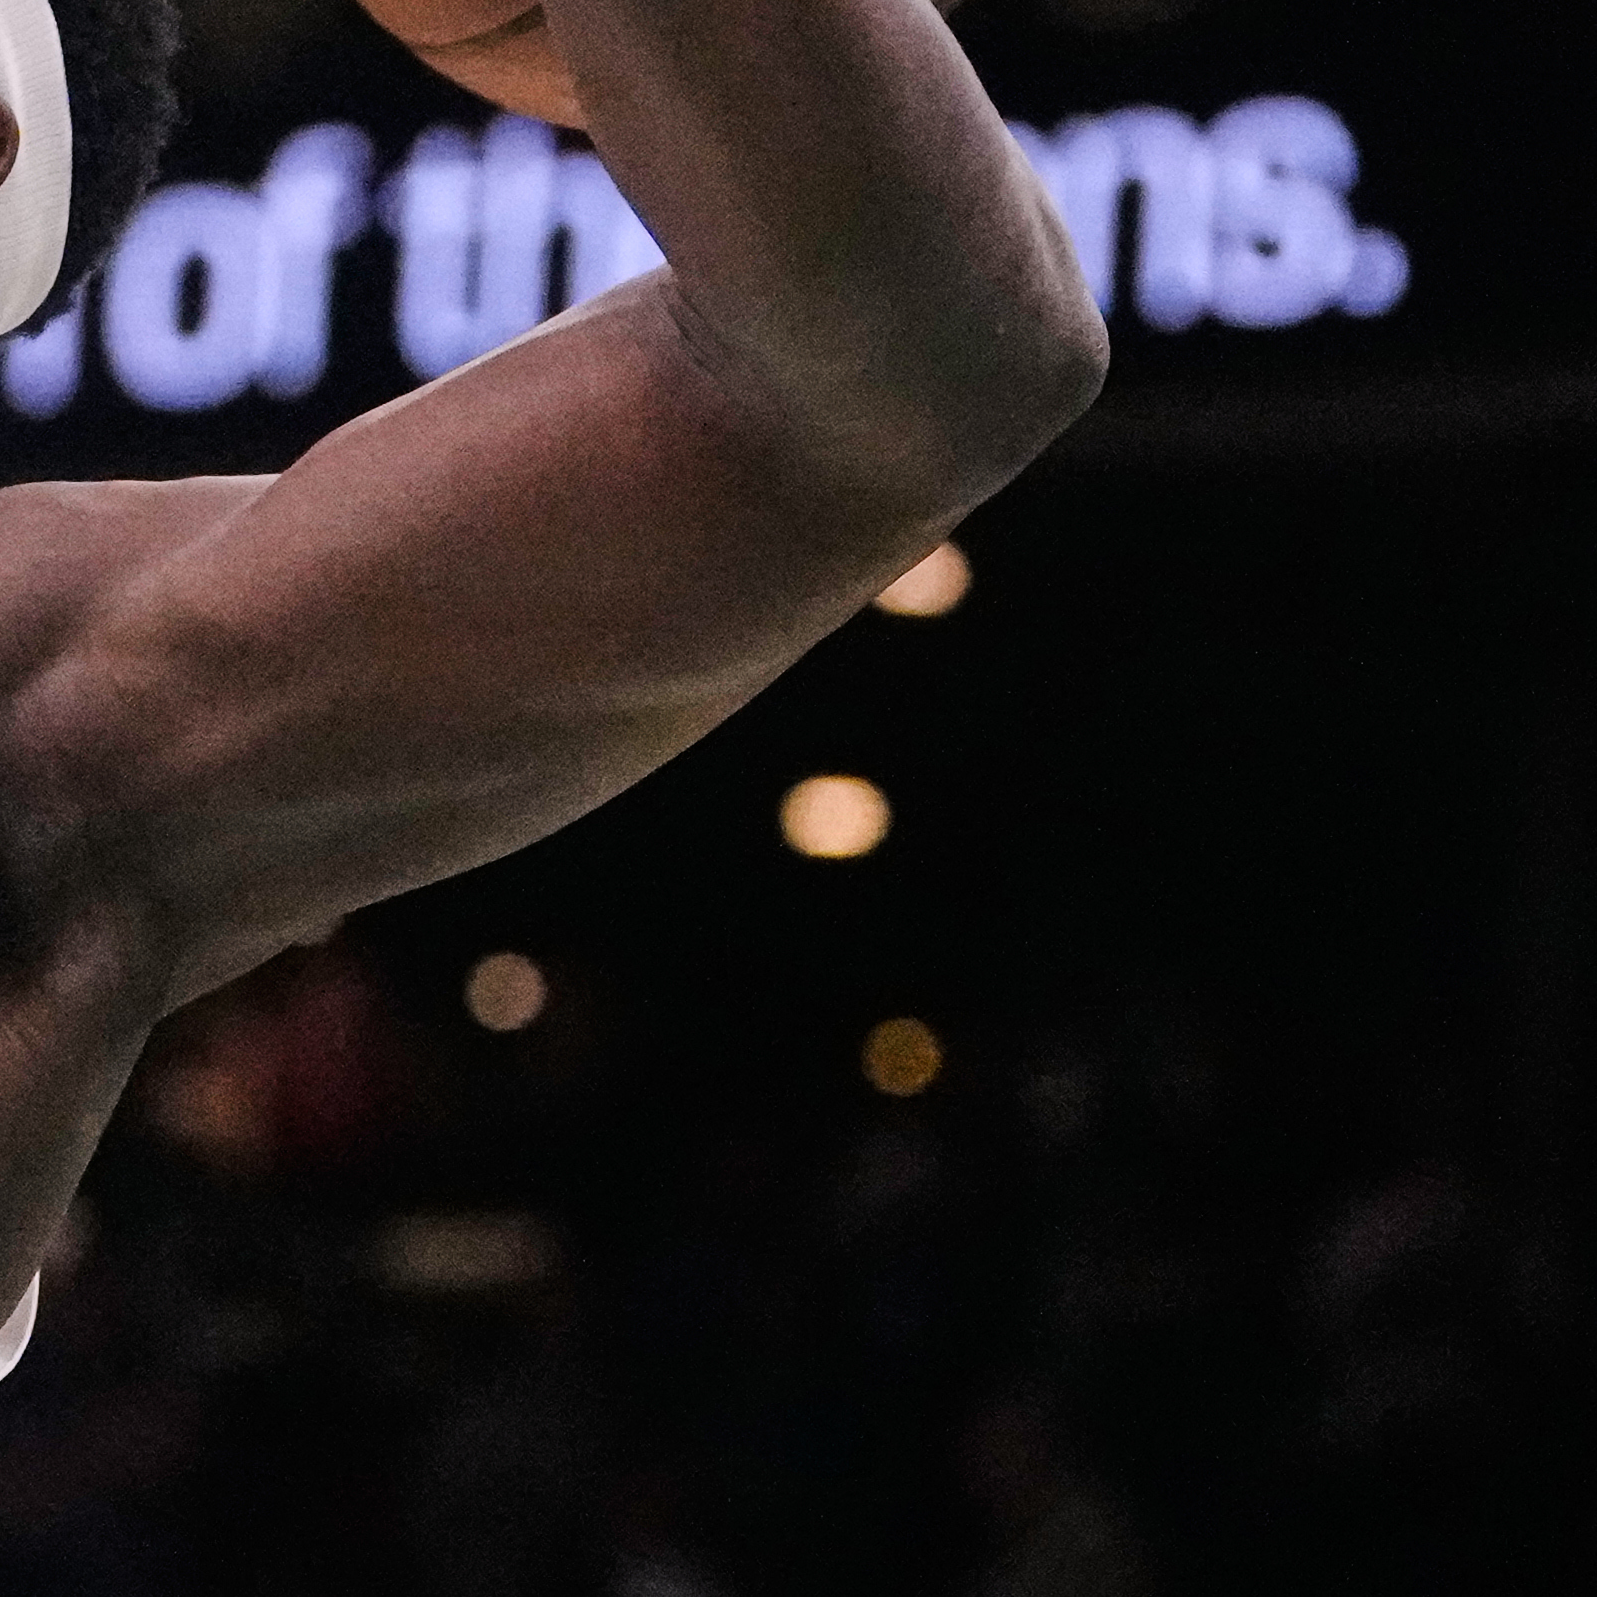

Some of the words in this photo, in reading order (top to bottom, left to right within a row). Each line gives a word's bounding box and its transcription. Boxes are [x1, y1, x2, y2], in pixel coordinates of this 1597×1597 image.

[104, 127, 363, 407] of
[385, 117, 664, 376] th
[1009, 98, 1407, 325] ns.
